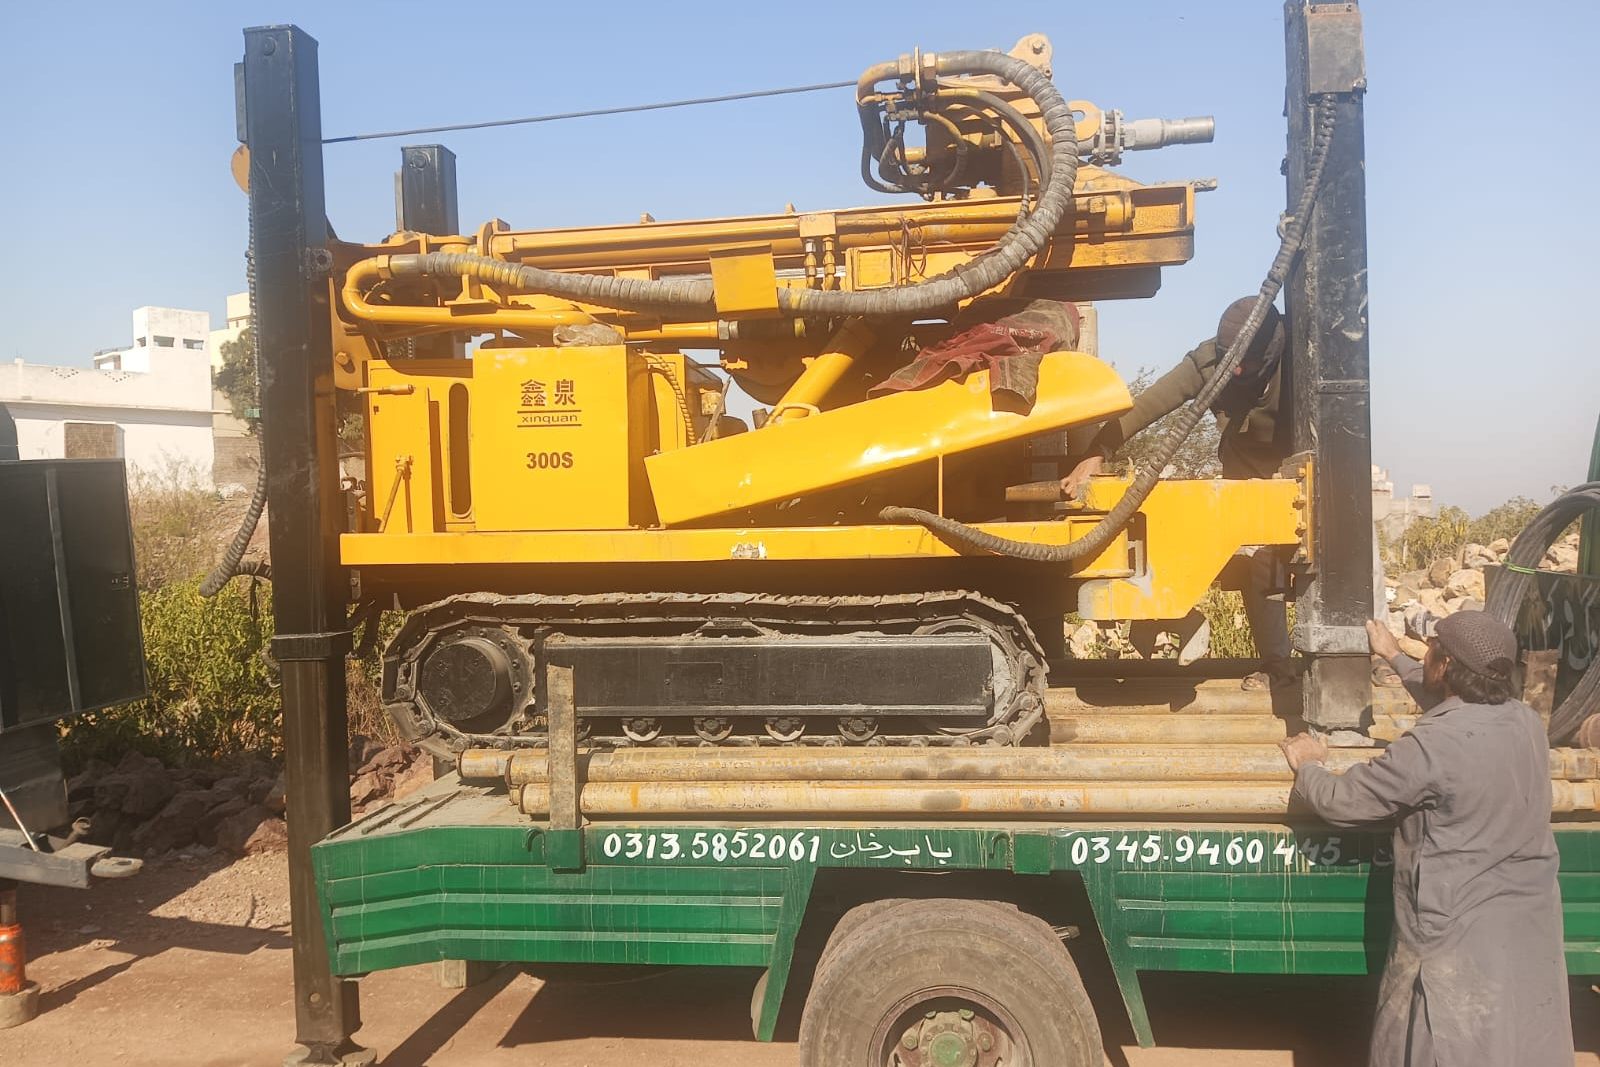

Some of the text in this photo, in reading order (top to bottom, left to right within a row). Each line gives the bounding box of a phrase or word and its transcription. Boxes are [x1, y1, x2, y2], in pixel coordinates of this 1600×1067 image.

[520, 378, 576, 407] 鑫泉
[521, 414, 578, 425] xinquan
[526, 451, 574, 470] 300S
[603, 832, 821, 862] 0313.5852061
